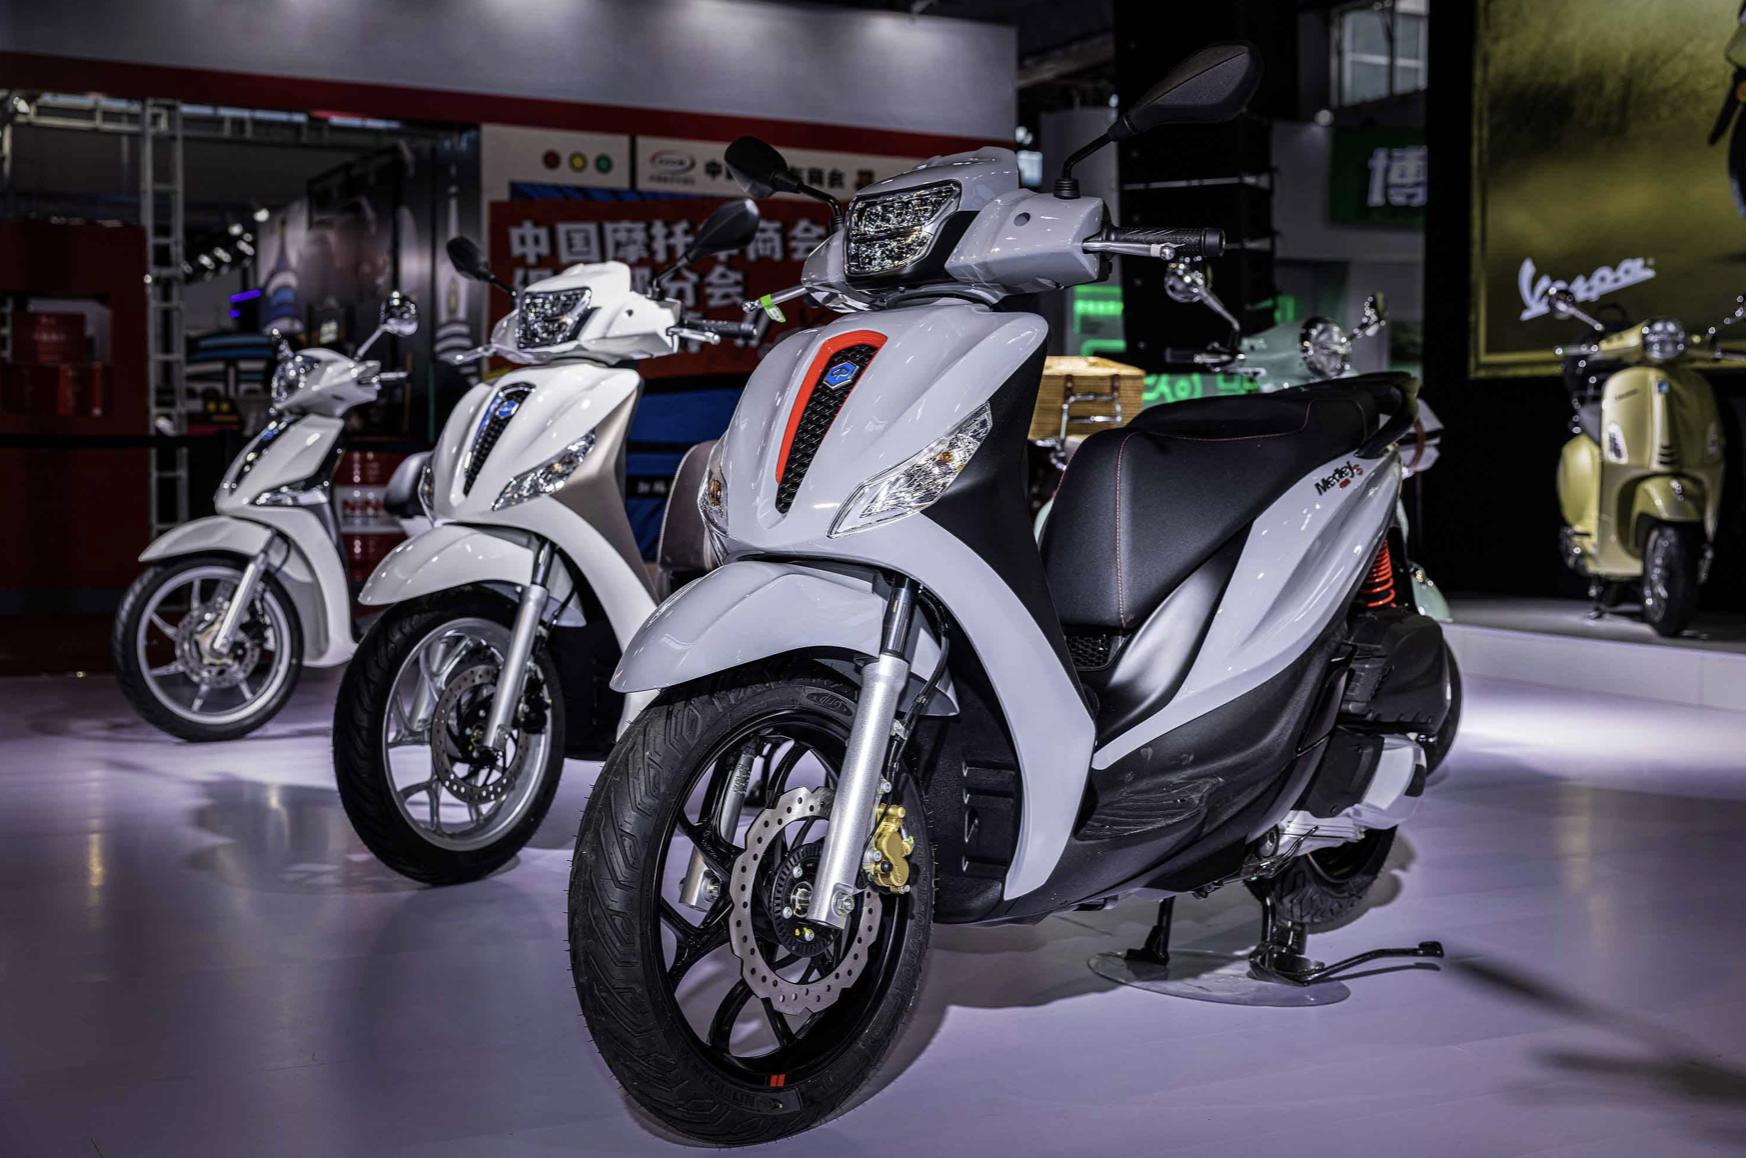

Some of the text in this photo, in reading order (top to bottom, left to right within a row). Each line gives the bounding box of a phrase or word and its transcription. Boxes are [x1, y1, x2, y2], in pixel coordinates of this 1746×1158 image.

[508, 219, 826, 264] 中国摩托商会
